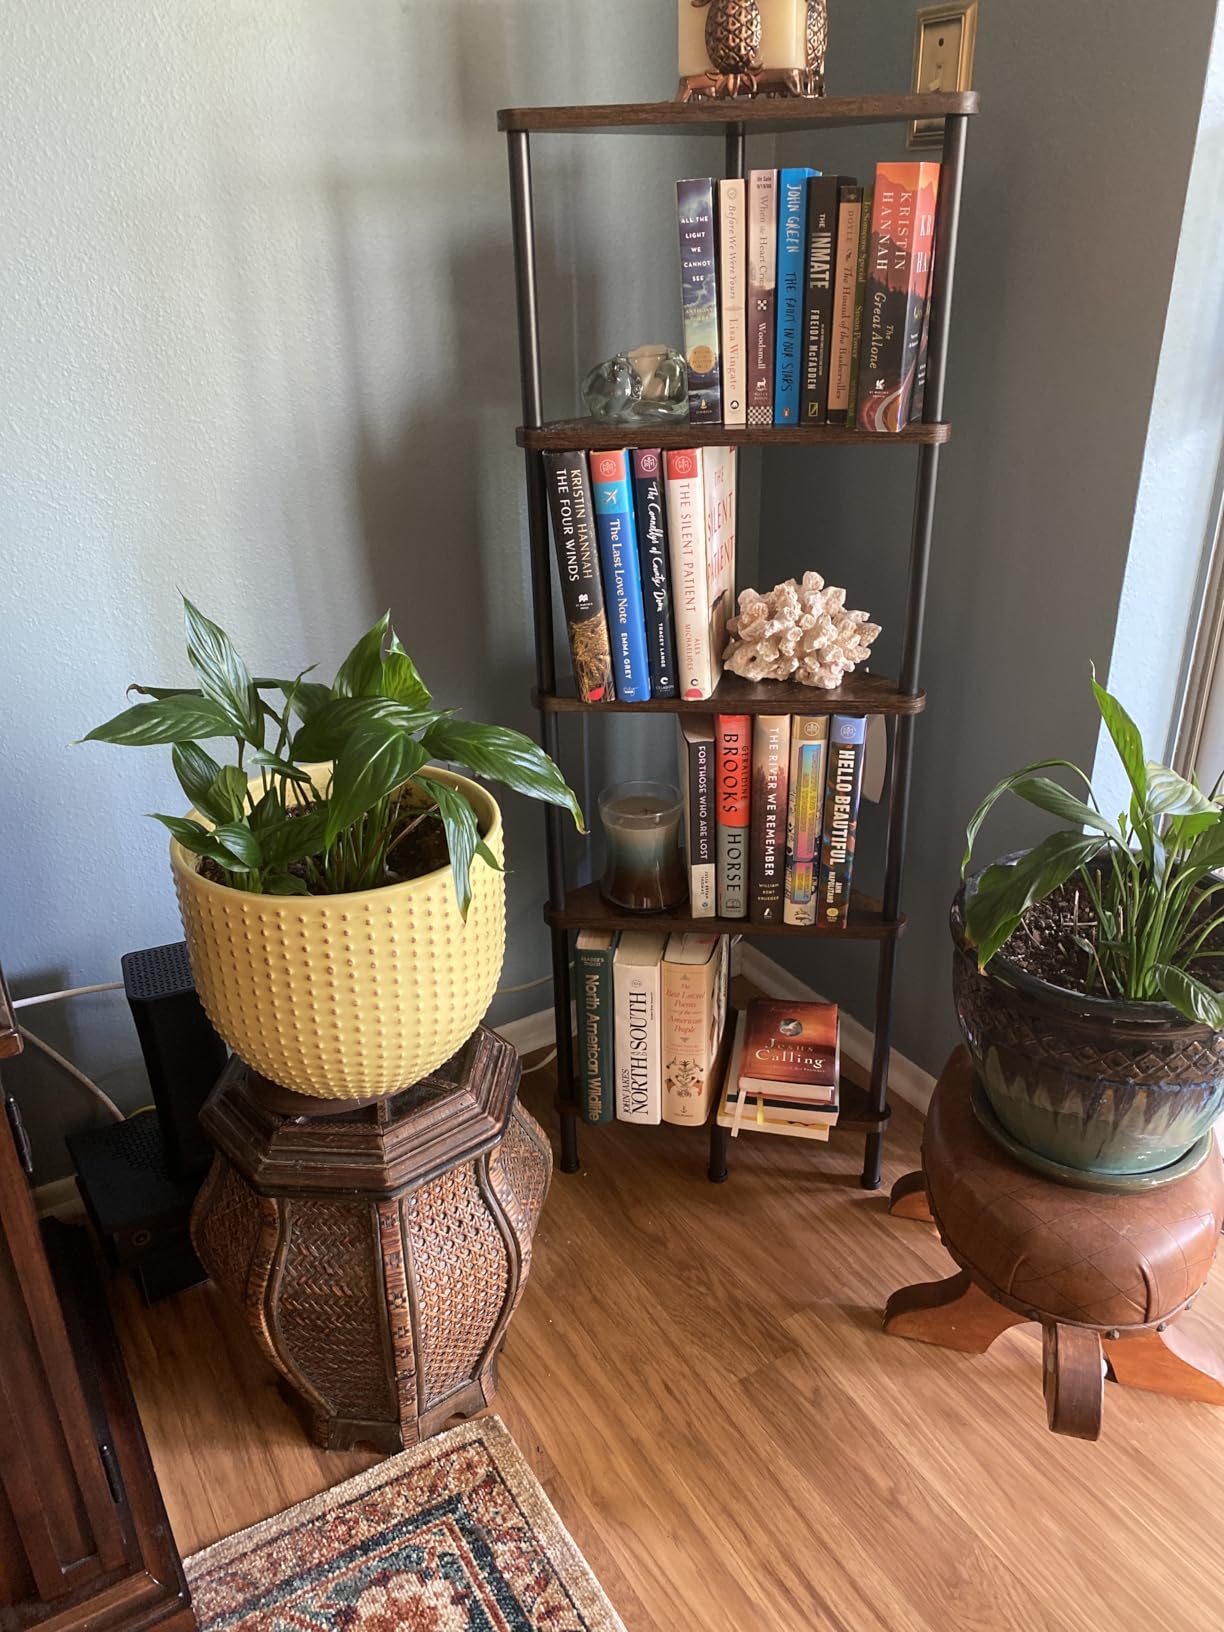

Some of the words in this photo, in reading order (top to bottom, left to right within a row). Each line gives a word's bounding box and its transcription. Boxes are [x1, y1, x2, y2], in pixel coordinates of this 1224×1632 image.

[760, 195, 768, 223] When
[786, 183, 802, 212] JOHN
[728, 205, 737, 235] Before
[785, 216, 801, 253] GREEN
[845, 210, 855, 241] DOYLE
[876, 192, 895, 270] HANNAH
[894, 192, 912, 270] KRISTIN
[729, 236, 737, 250] We
[760, 237, 768, 261] Heart
[684, 260, 711, 268] CANNOT
[728, 252, 737, 273] Were
[810, 232, 831, 289] INMATE
[843, 268, 853, 282] The
[729, 275, 737, 300] Yours
[784, 272, 797, 293] THE
[809, 309, 820, 340] FREIDA
[872, 291, 887, 329] Great
[729, 319, 739, 342] Lisa
[784, 328, 795, 339] IN
[885, 324, 895, 341] The
[758, 322, 767, 369] Woodsmall
[869, 331, 883, 369] Alone
[727, 343, 739, 391] Wingate
[807, 345, 819, 390] McFADDEN
[556, 468, 569, 494] THE
[571, 469, 586, 518] KRISTIN
[646, 481, 659, 500] The
[680, 483, 691, 507] THE
[559, 499, 574, 535] FOUR
[609, 518, 621, 541] The
[680, 513, 693, 556] SILENT
[565, 539, 579, 582] WINDS
[577, 523, 593, 579] HANNAH
[612, 543, 623, 567] Last
[614, 570, 626, 596] Love
[651, 557, 666, 587] County
[683, 562, 696, 613] PATIENT
[617, 598, 628, 624] Note
[620, 632, 630, 656] EMMA
[623, 658, 633, 679] GREY
[768, 728, 780, 751] THE
[698, 745, 706, 764] FOR
[698, 765, 706, 793] THOSE
[722, 733, 739, 813] BROOKS
[740, 745, 749, 800] GERALDINE
[767, 755, 779, 790] RIVER
[835, 749, 856, 792] HELLO
[699, 795, 707, 818] WHO
[766, 793, 777, 811] WE
[699, 820, 708, 837] ARE
[829, 795, 851, 866] BEAUTIFUL
[700, 839, 708, 860] LOST
[764, 814, 776, 876] REMEMBER
[726, 833, 742, 892] HORSE
[585, 974, 600, 1010] North
[629, 991, 648, 1051] SOUTH
[586, 1012, 601, 1076] American
[755, 1048, 825, 1069] Calling
[764, 1038, 814, 1052] Jesus
[621, 1068, 632, 1093] JAKES
[630, 1056, 649, 1115] NORTH
[587, 1077, 603, 1121] Wildlife
[622, 1094, 632, 1115] JOHN
